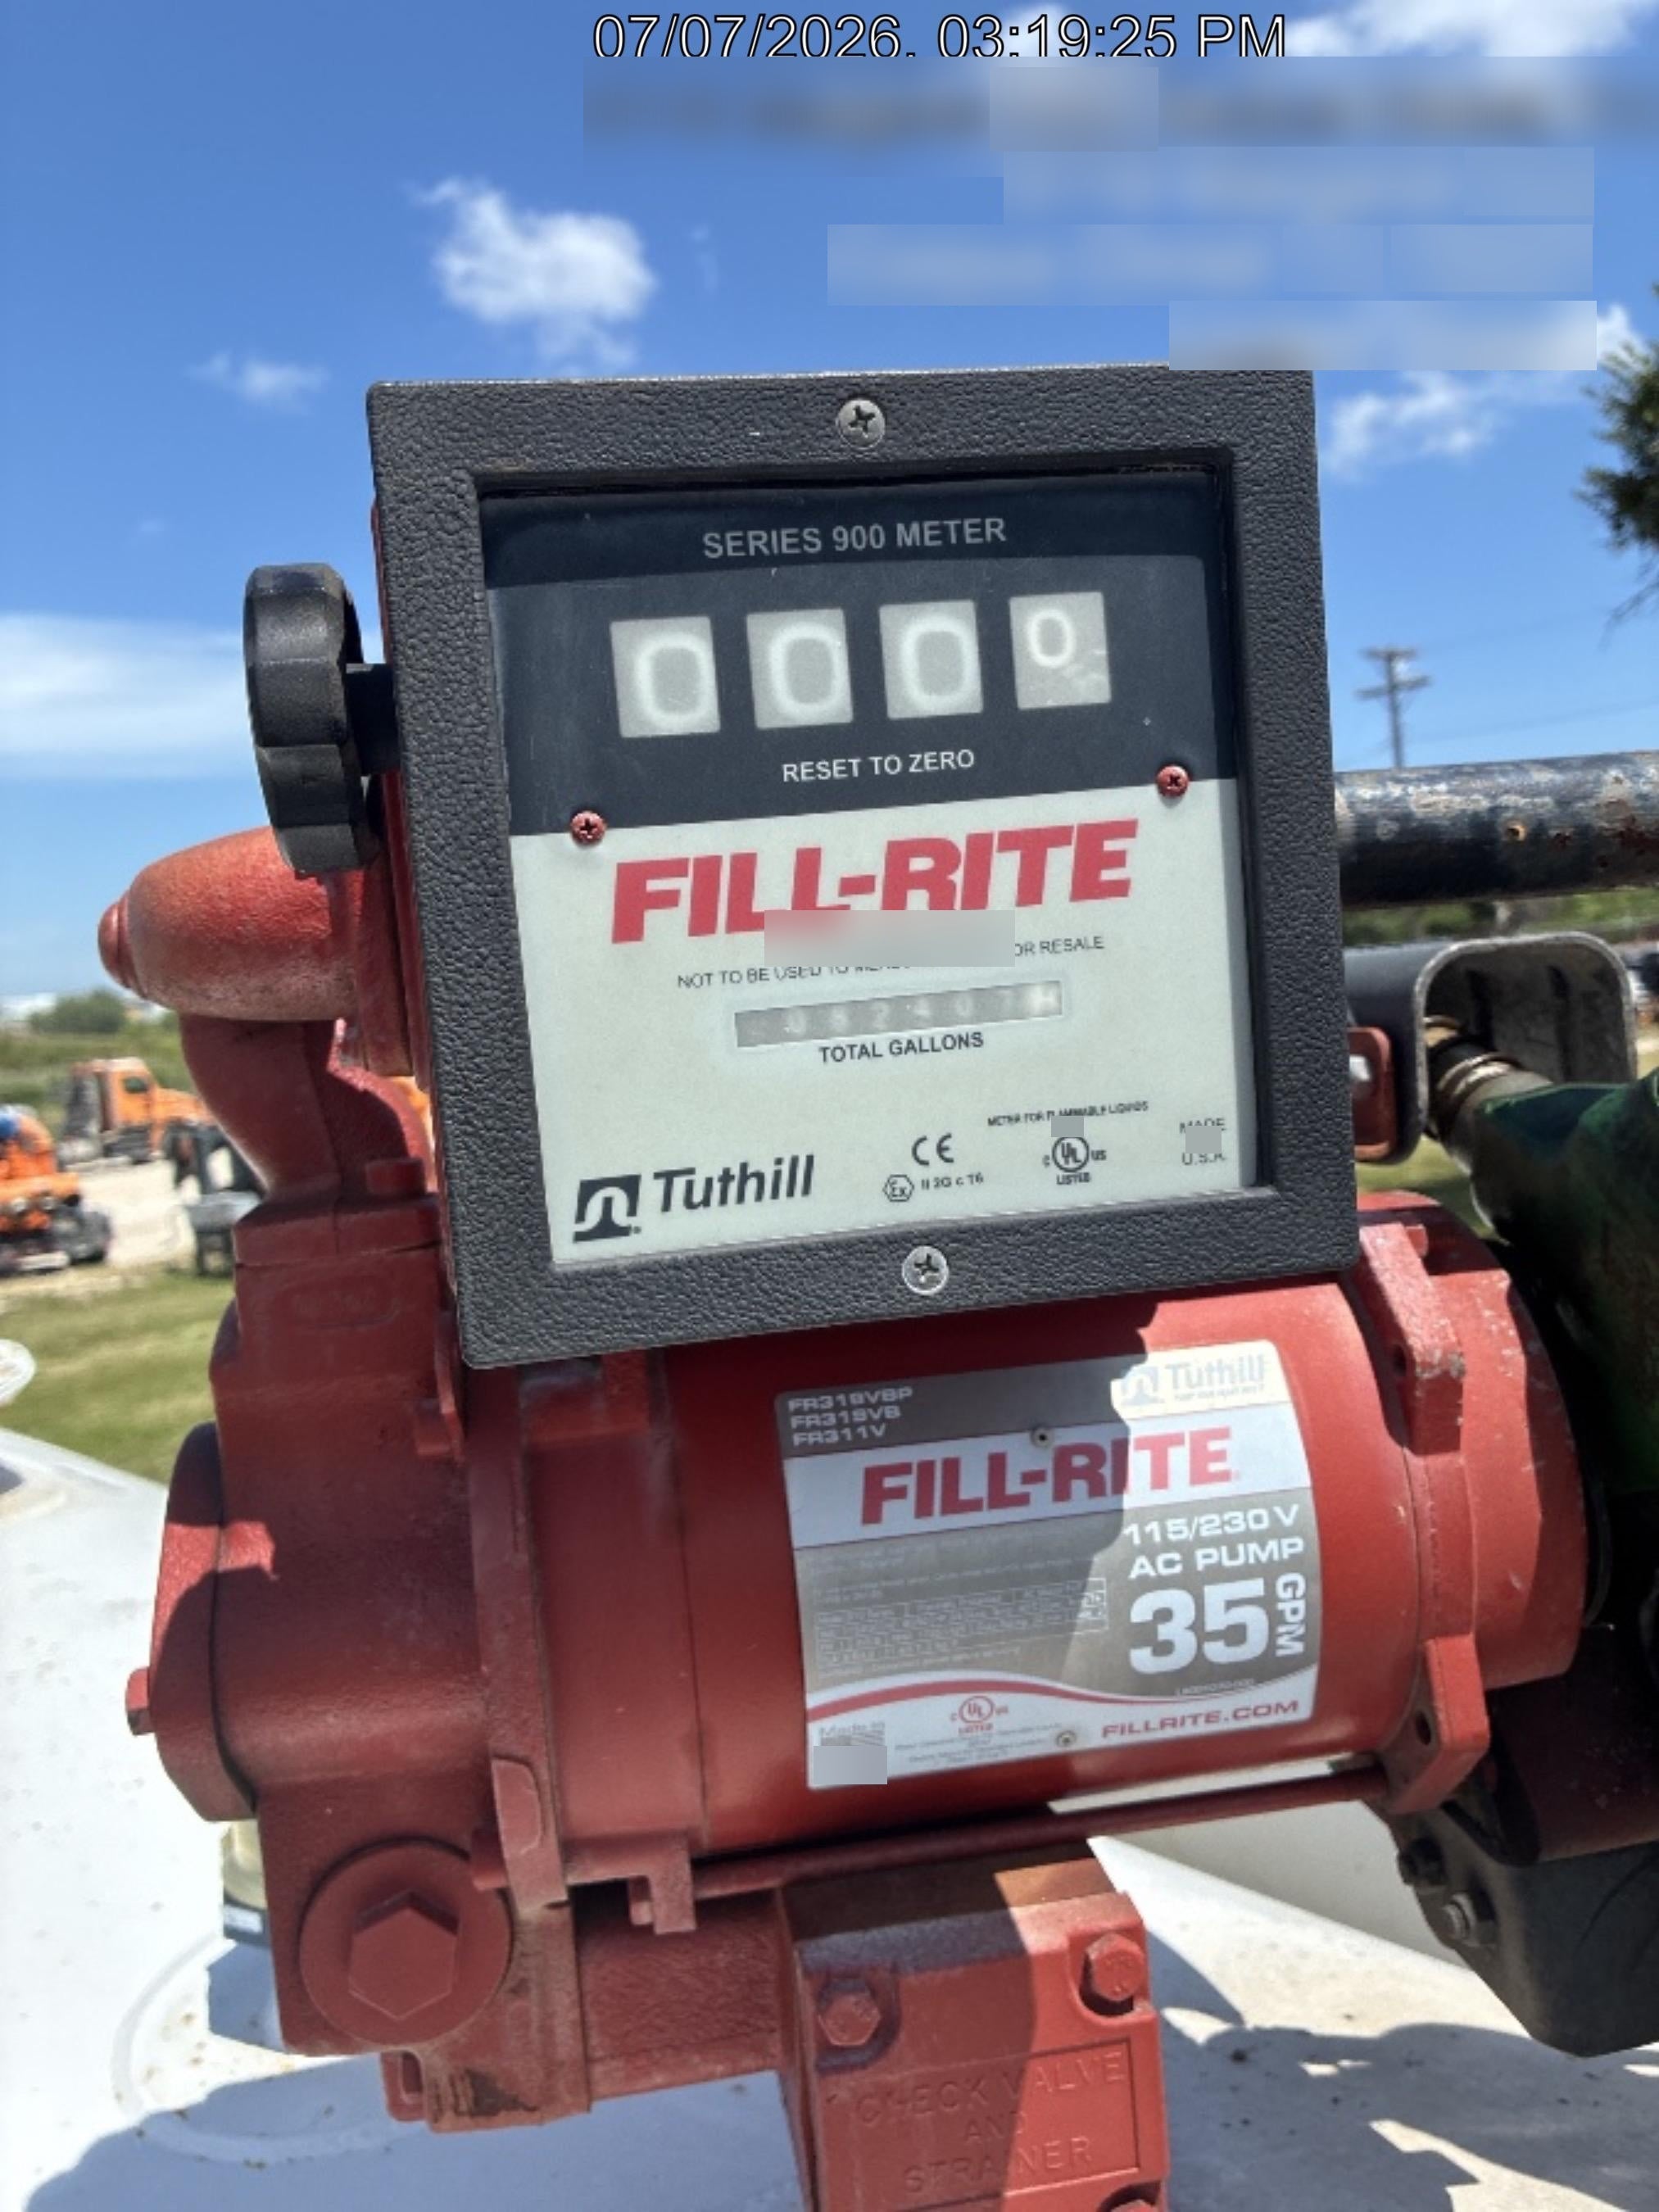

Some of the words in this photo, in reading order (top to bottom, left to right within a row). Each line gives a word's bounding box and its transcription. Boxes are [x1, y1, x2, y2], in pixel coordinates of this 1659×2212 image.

[702, 527, 823, 559] SERIES
[832, 524, 886, 551] 900
[895, 517, 1007, 547] METER
[782, 758, 862, 782] RESET
[868, 754, 903, 775] TO
[908, 749, 975, 773] ZERO
[612, 818, 1139, 944] FILL-RITE
[678, 972, 714, 988] NOT
[719, 969, 741, 984] TO
[746, 968, 770, 983] BE
[1040, 936, 1104, 954] RESALE
[818, 1041, 883, 1063] TOTAL
[888, 1031, 985, 1056] GALLONS
[911, 1131, 955, 1166] CE
[653, 1154, 815, 1213] Tuthill
[1164, 1353, 1267, 1391] Tuthill
[860, 1424, 1232, 1525] FILL-RITE
[1123, 1507, 1270, 1546] 115/230
[1273, 1503, 1299, 1528] V
[1127, 1552, 1183, 1580] AC
[1194, 1535, 1305, 1572] PUMP
[1129, 1576, 1270, 1675] 35
[1275, 1571, 1307, 1657] GPM
[1101, 1699, 1299, 1738] FILLRITE.COM
[855, 2072, 990, 2128] CHECK
[1002, 2050, 1127, 2101] VALVE
[963, 2109, 1030, 2146] AND
